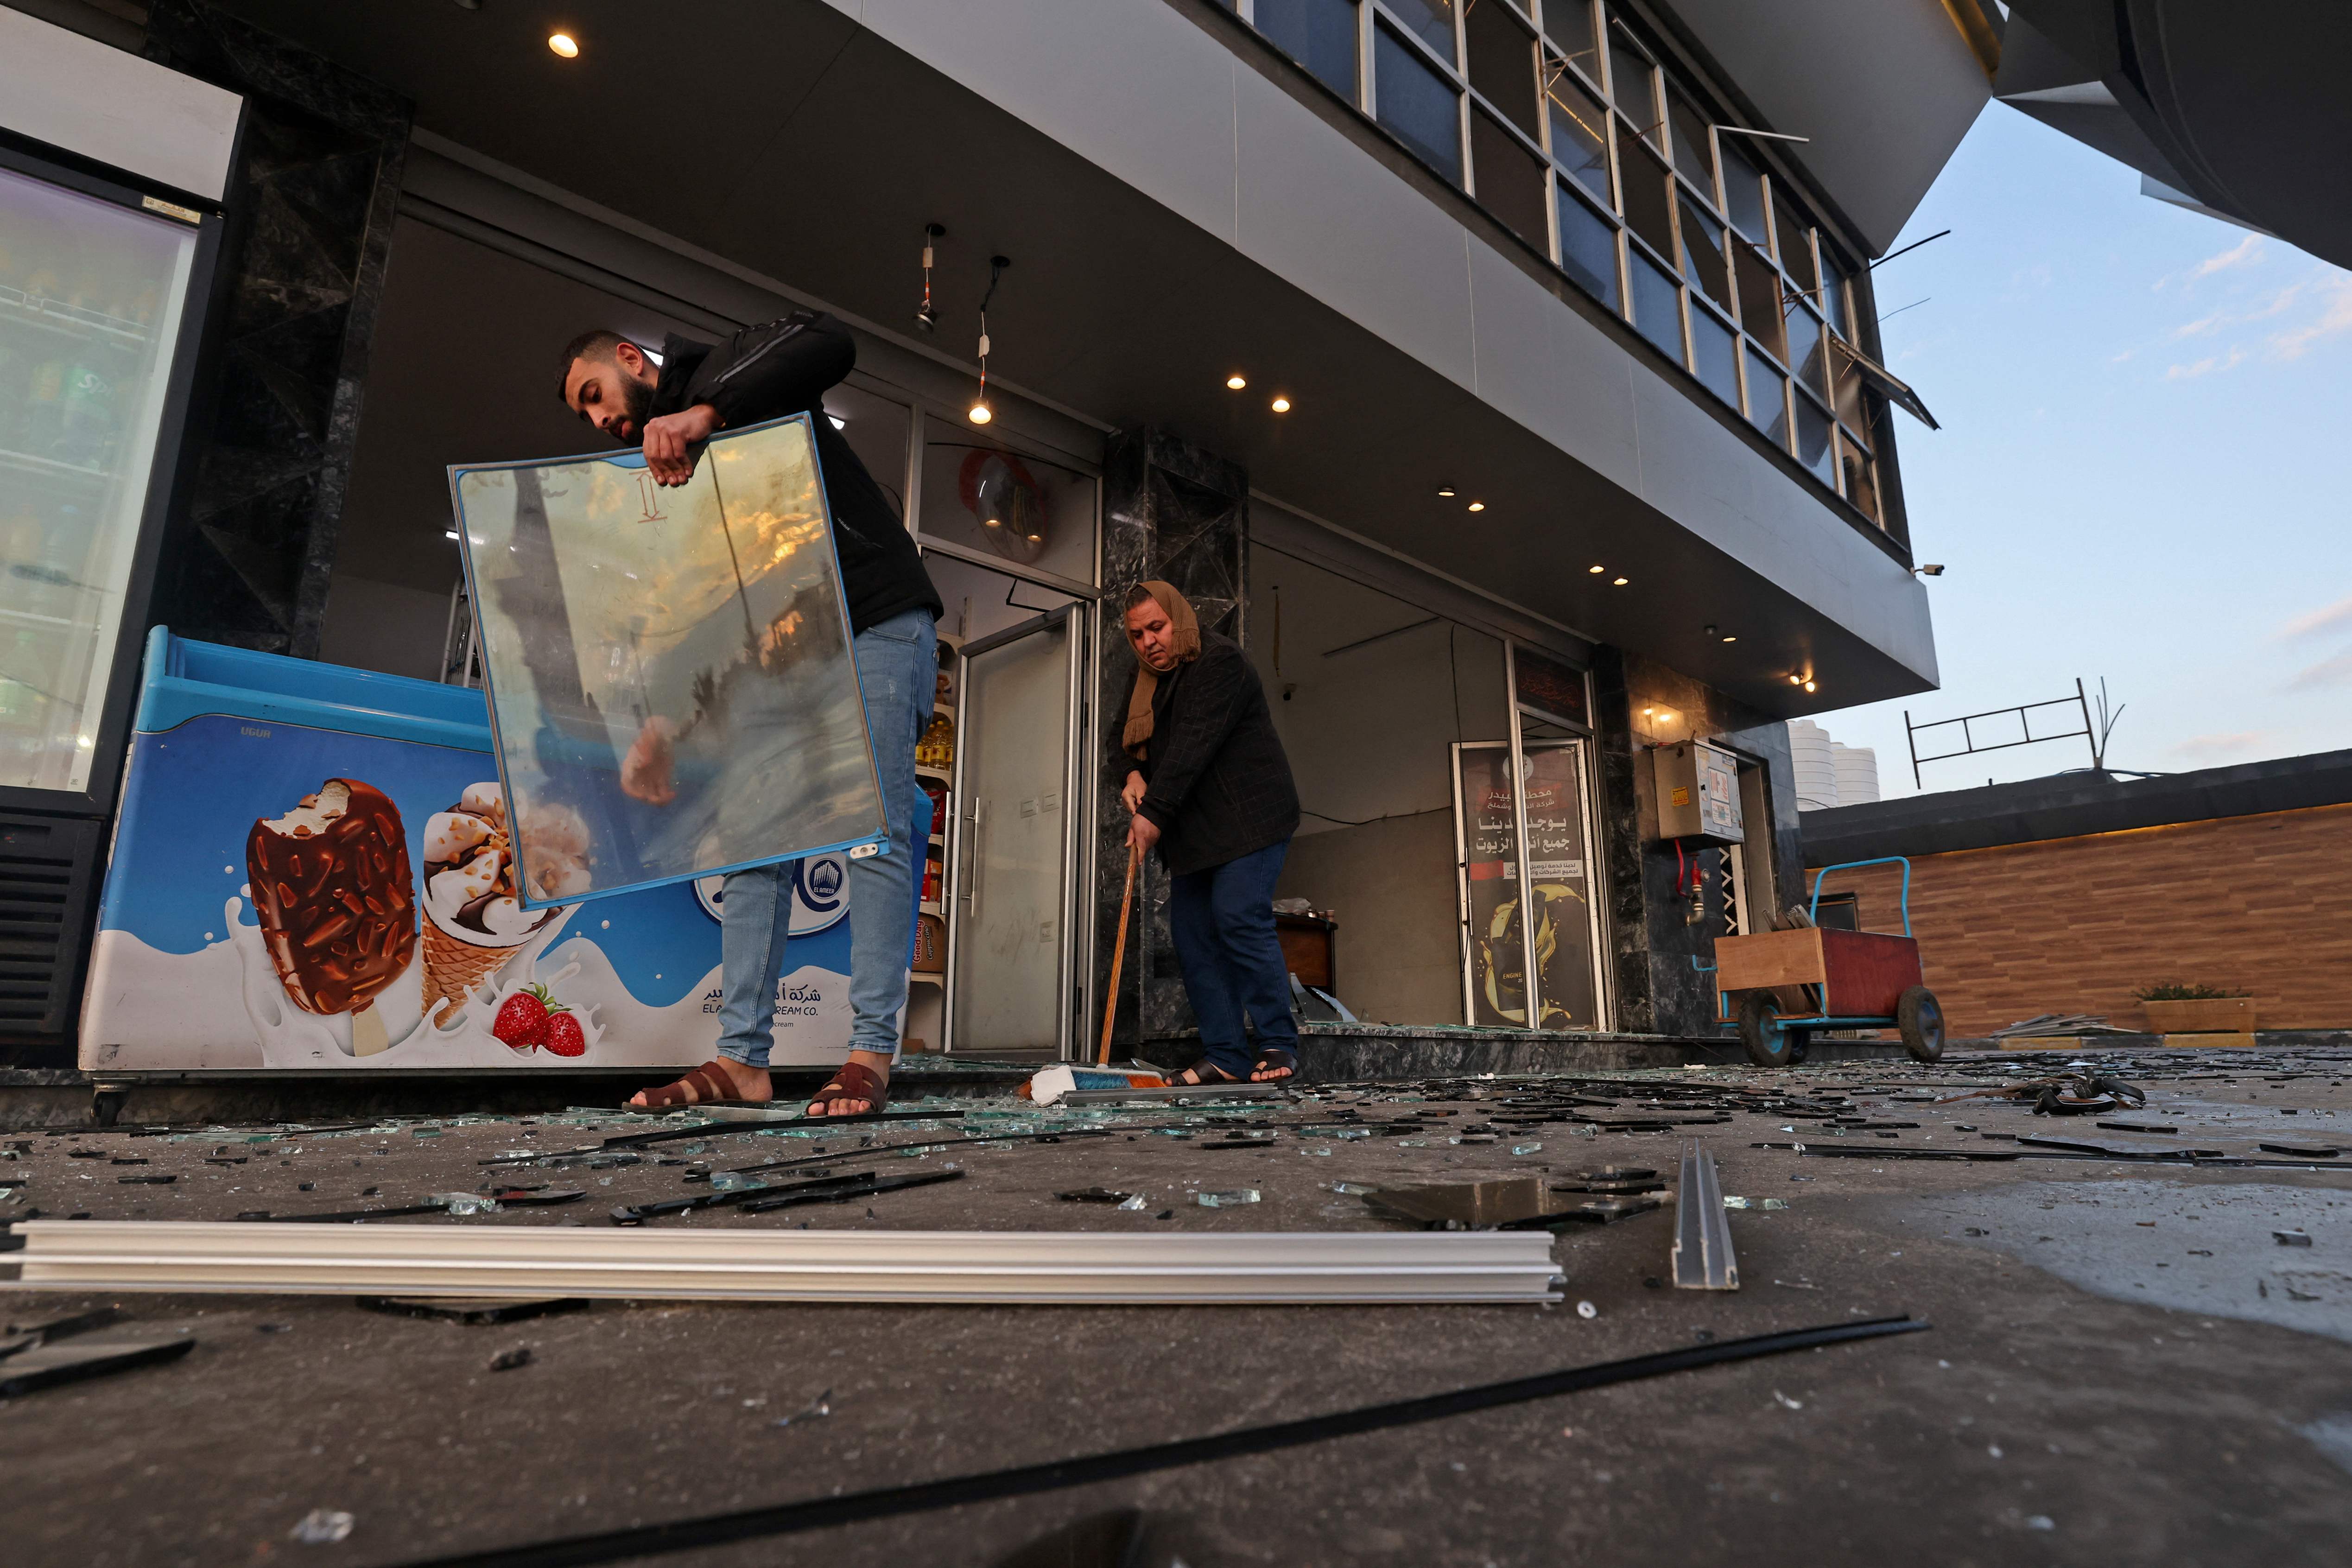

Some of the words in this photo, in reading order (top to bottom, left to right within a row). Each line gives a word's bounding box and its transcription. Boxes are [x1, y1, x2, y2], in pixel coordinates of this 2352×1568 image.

[1536, 799, 1554, 808] شركة
[1476, 837, 1513, 853] الزيوت
[1543, 838, 1570, 853] جميع
[925, 926, 933, 960] Cappuccino
[913, 940, 921, 963] Good
[789, 984, 821, 1003] شركة
[804, 1007, 818, 1016] CO.
